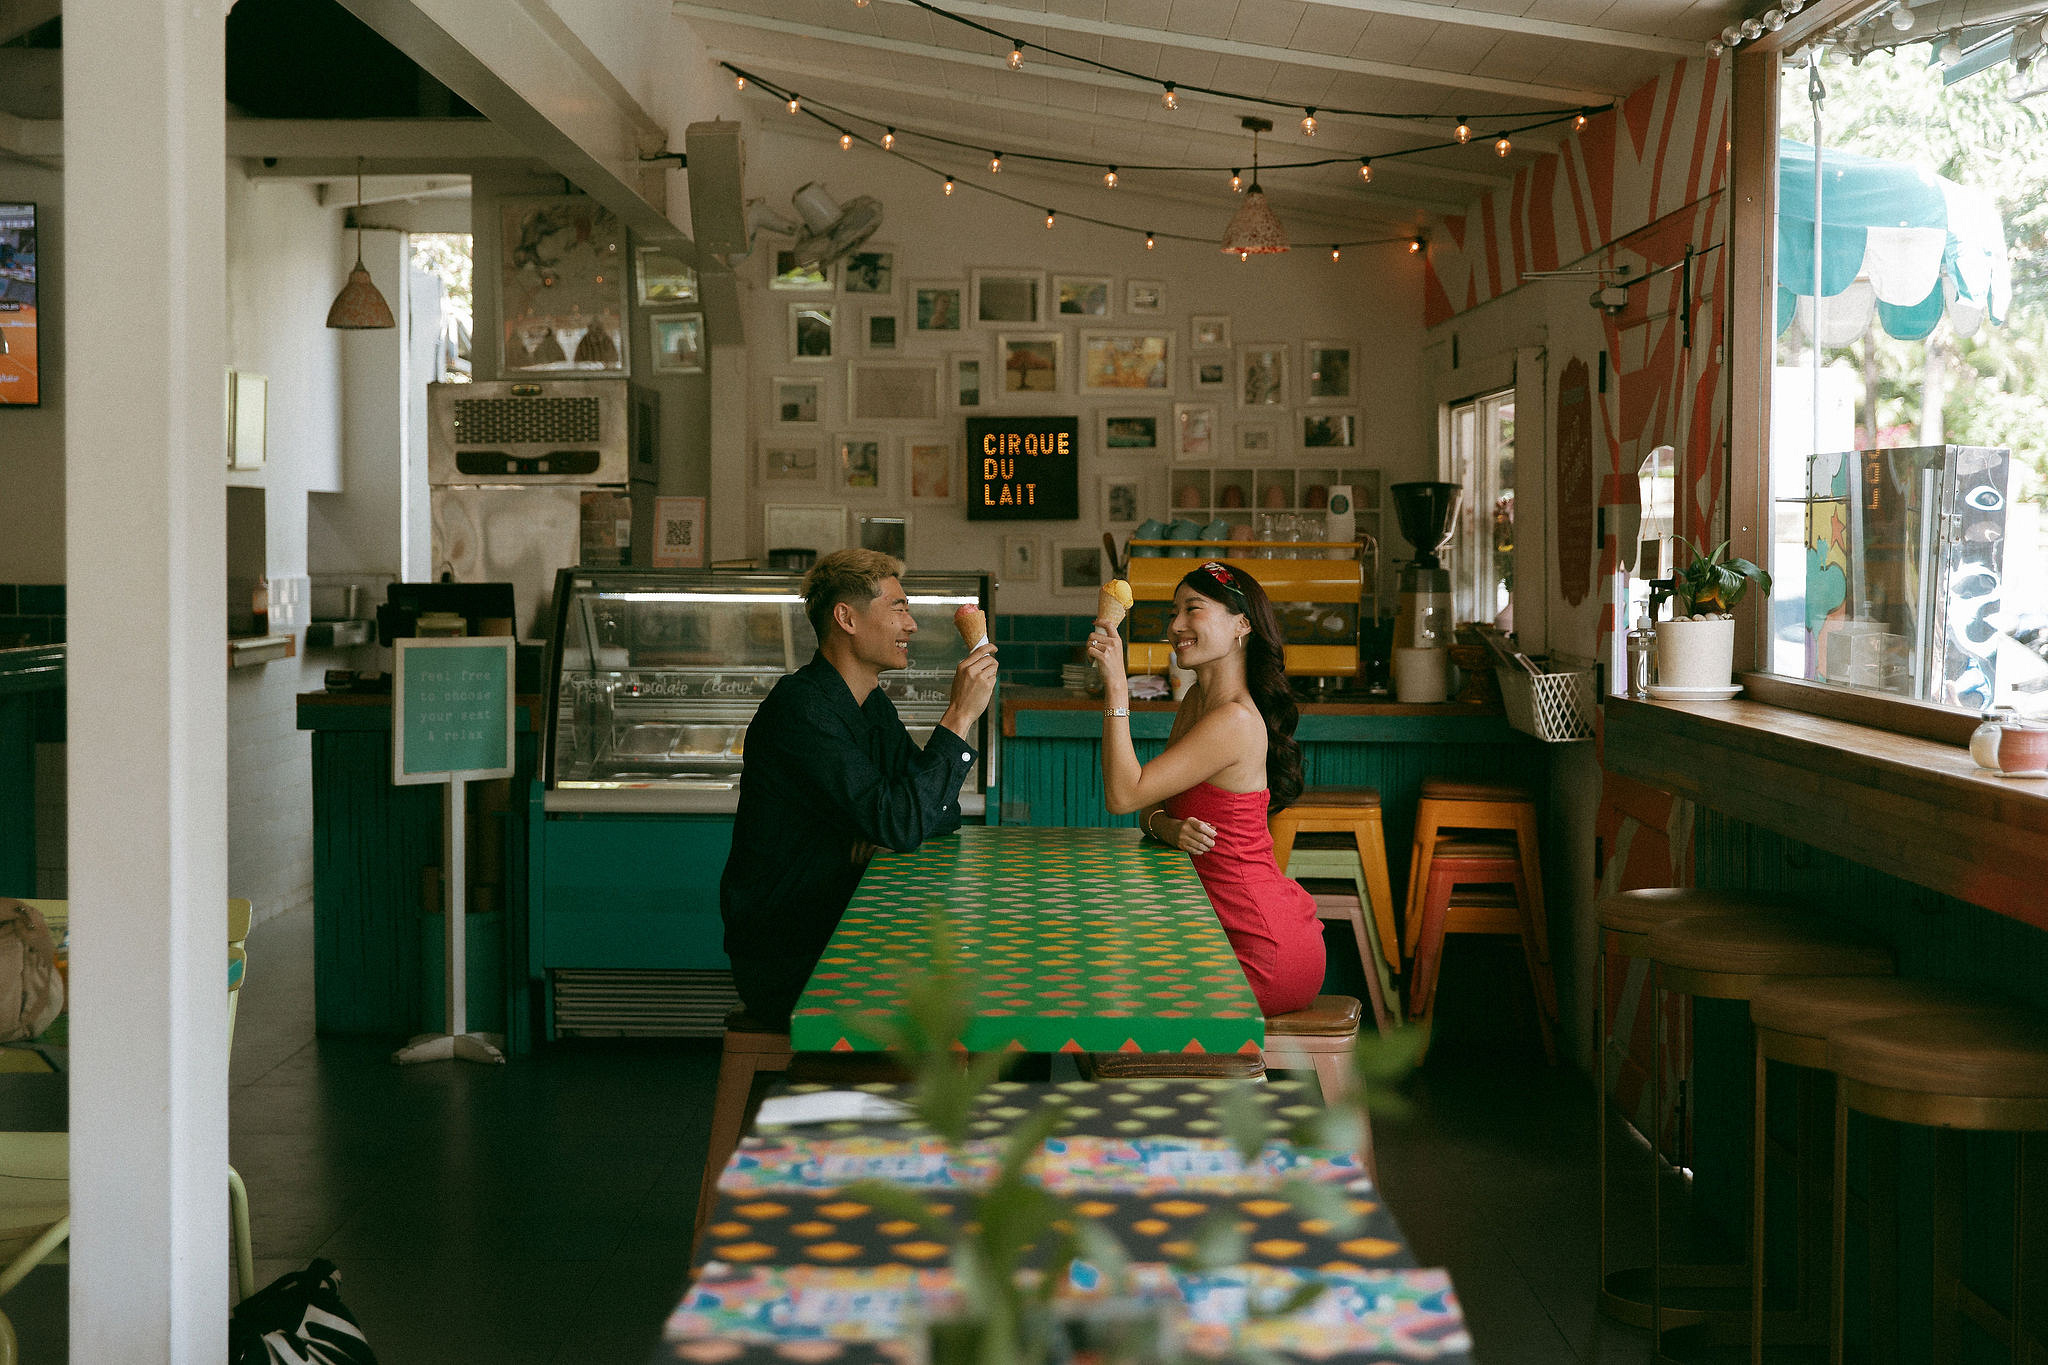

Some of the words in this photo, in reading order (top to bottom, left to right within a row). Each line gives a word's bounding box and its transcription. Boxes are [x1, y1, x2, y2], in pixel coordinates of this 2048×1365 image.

[983, 432, 1070, 456] CIRQUE
[983, 458, 1014, 480] DU
[984, 483, 1037, 506] LAIT
[420, 692, 435, 702] to
[444, 690, 491, 702] choose
[420, 711, 453, 724] your
[461, 709, 491, 722] seat
[444, 729, 483, 742] relax
